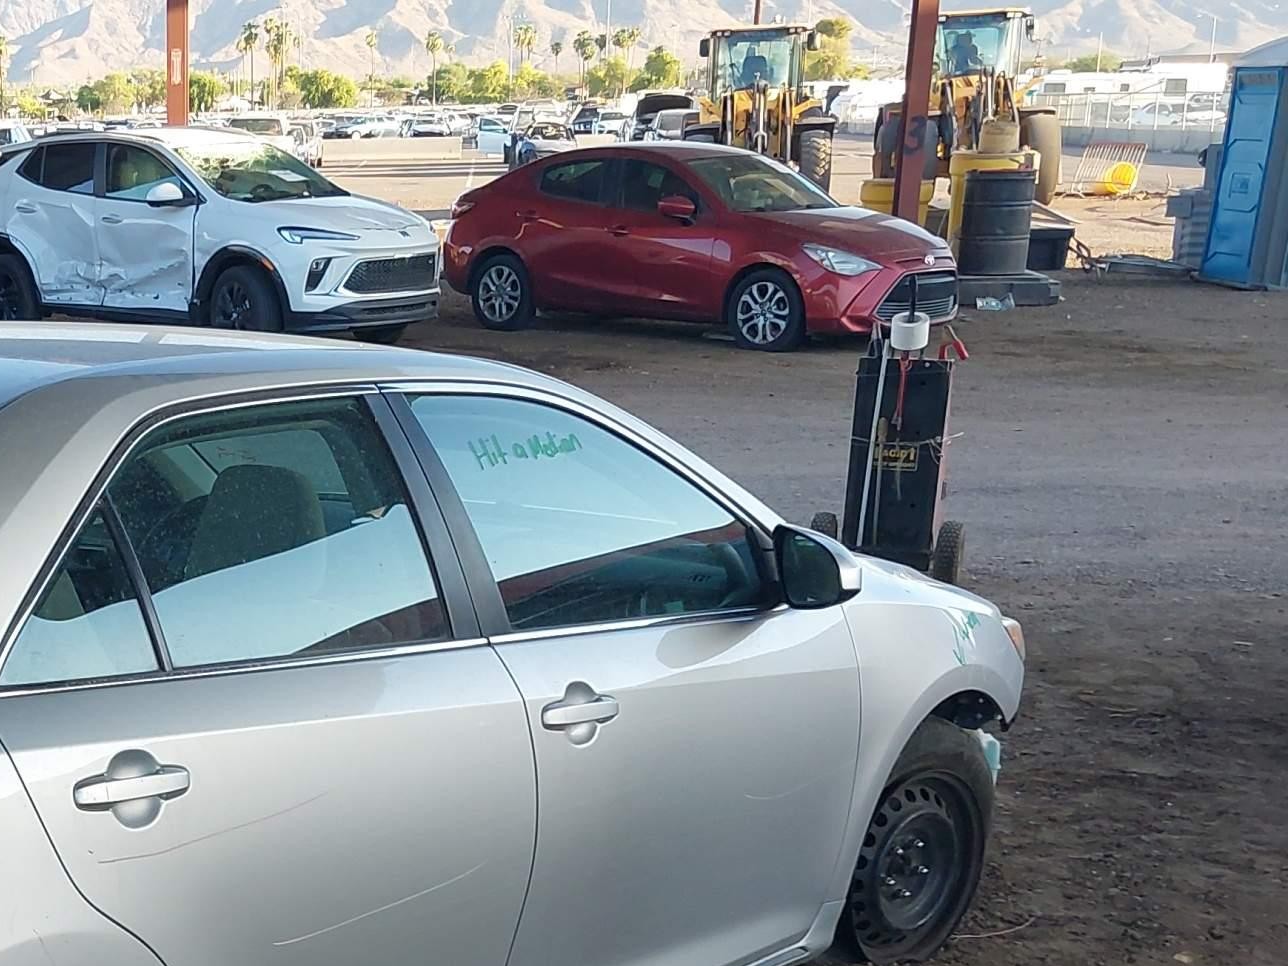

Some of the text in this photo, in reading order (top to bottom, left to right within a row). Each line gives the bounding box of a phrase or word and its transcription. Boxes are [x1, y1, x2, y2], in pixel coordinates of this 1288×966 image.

[904, 115, 926, 155] 3
[467, 434, 508, 470] Hit
[512, 443, 528, 459] a
